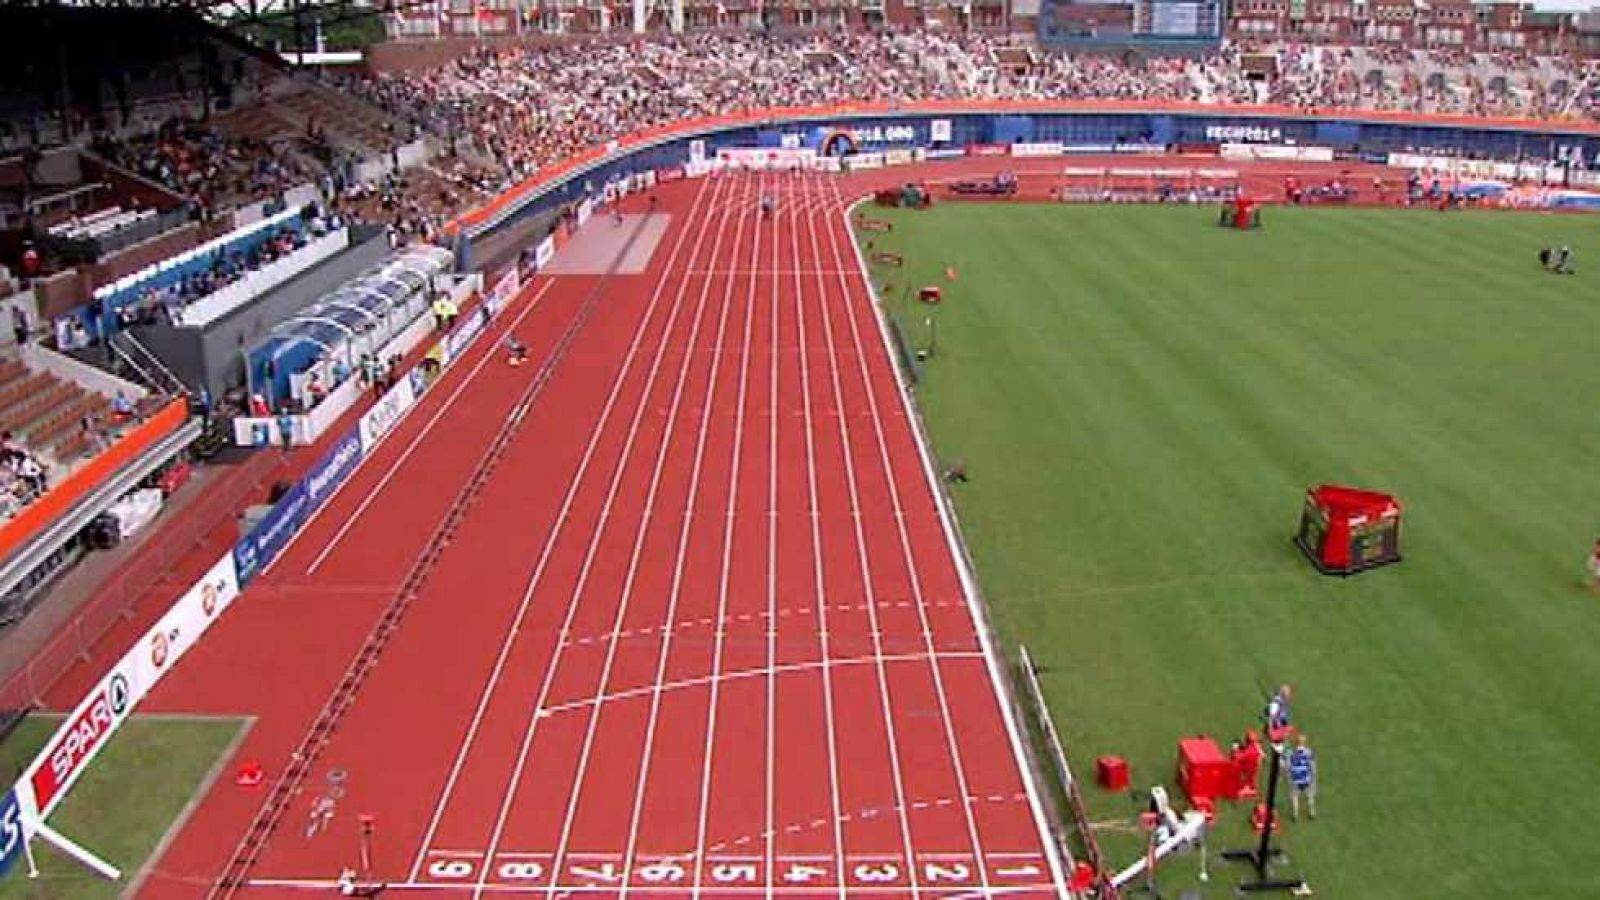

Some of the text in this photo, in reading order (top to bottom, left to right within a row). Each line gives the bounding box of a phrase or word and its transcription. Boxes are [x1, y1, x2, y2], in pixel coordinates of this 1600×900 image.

[52, 700, 112, 784] SPAR
[428, 862, 473, 877] 9
[500, 862, 542, 878] 8
[569, 862, 622, 881] 7
[640, 863, 684, 881] 6
[712, 863, 757, 881] 5
[783, 863, 827, 881] 4
[854, 863, 898, 881] 3
[926, 863, 969, 881] 2
[996, 865, 1039, 876] 1
